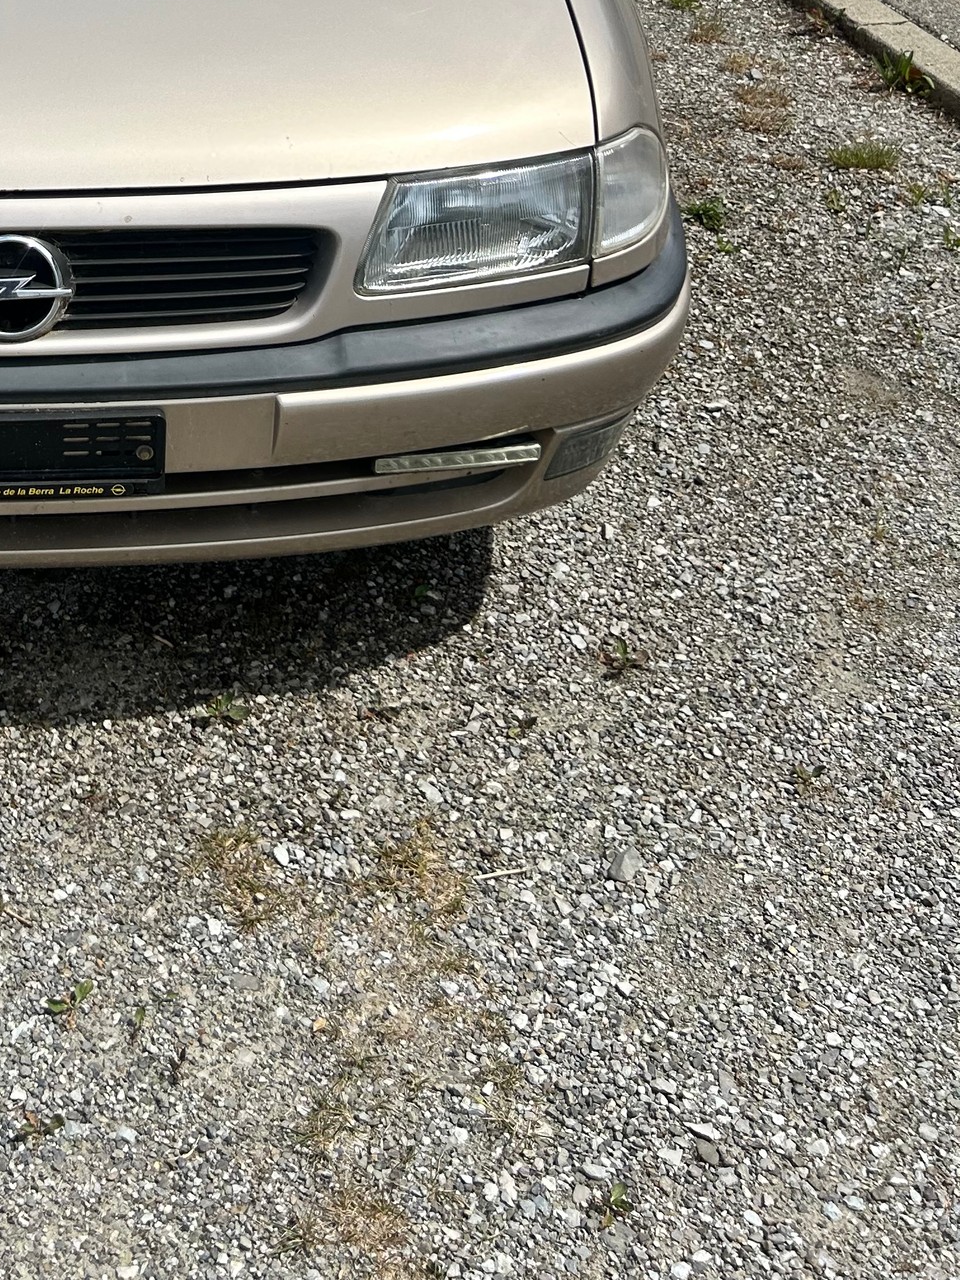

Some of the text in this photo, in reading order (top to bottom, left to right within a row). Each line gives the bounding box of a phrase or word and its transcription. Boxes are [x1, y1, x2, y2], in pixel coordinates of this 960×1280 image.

[3, 488, 15, 496] de
[17, 488, 26, 496] la
[28, 487, 55, 495] Berra
[59, 487, 71, 495] La
[73, 486, 104, 494] Roche
